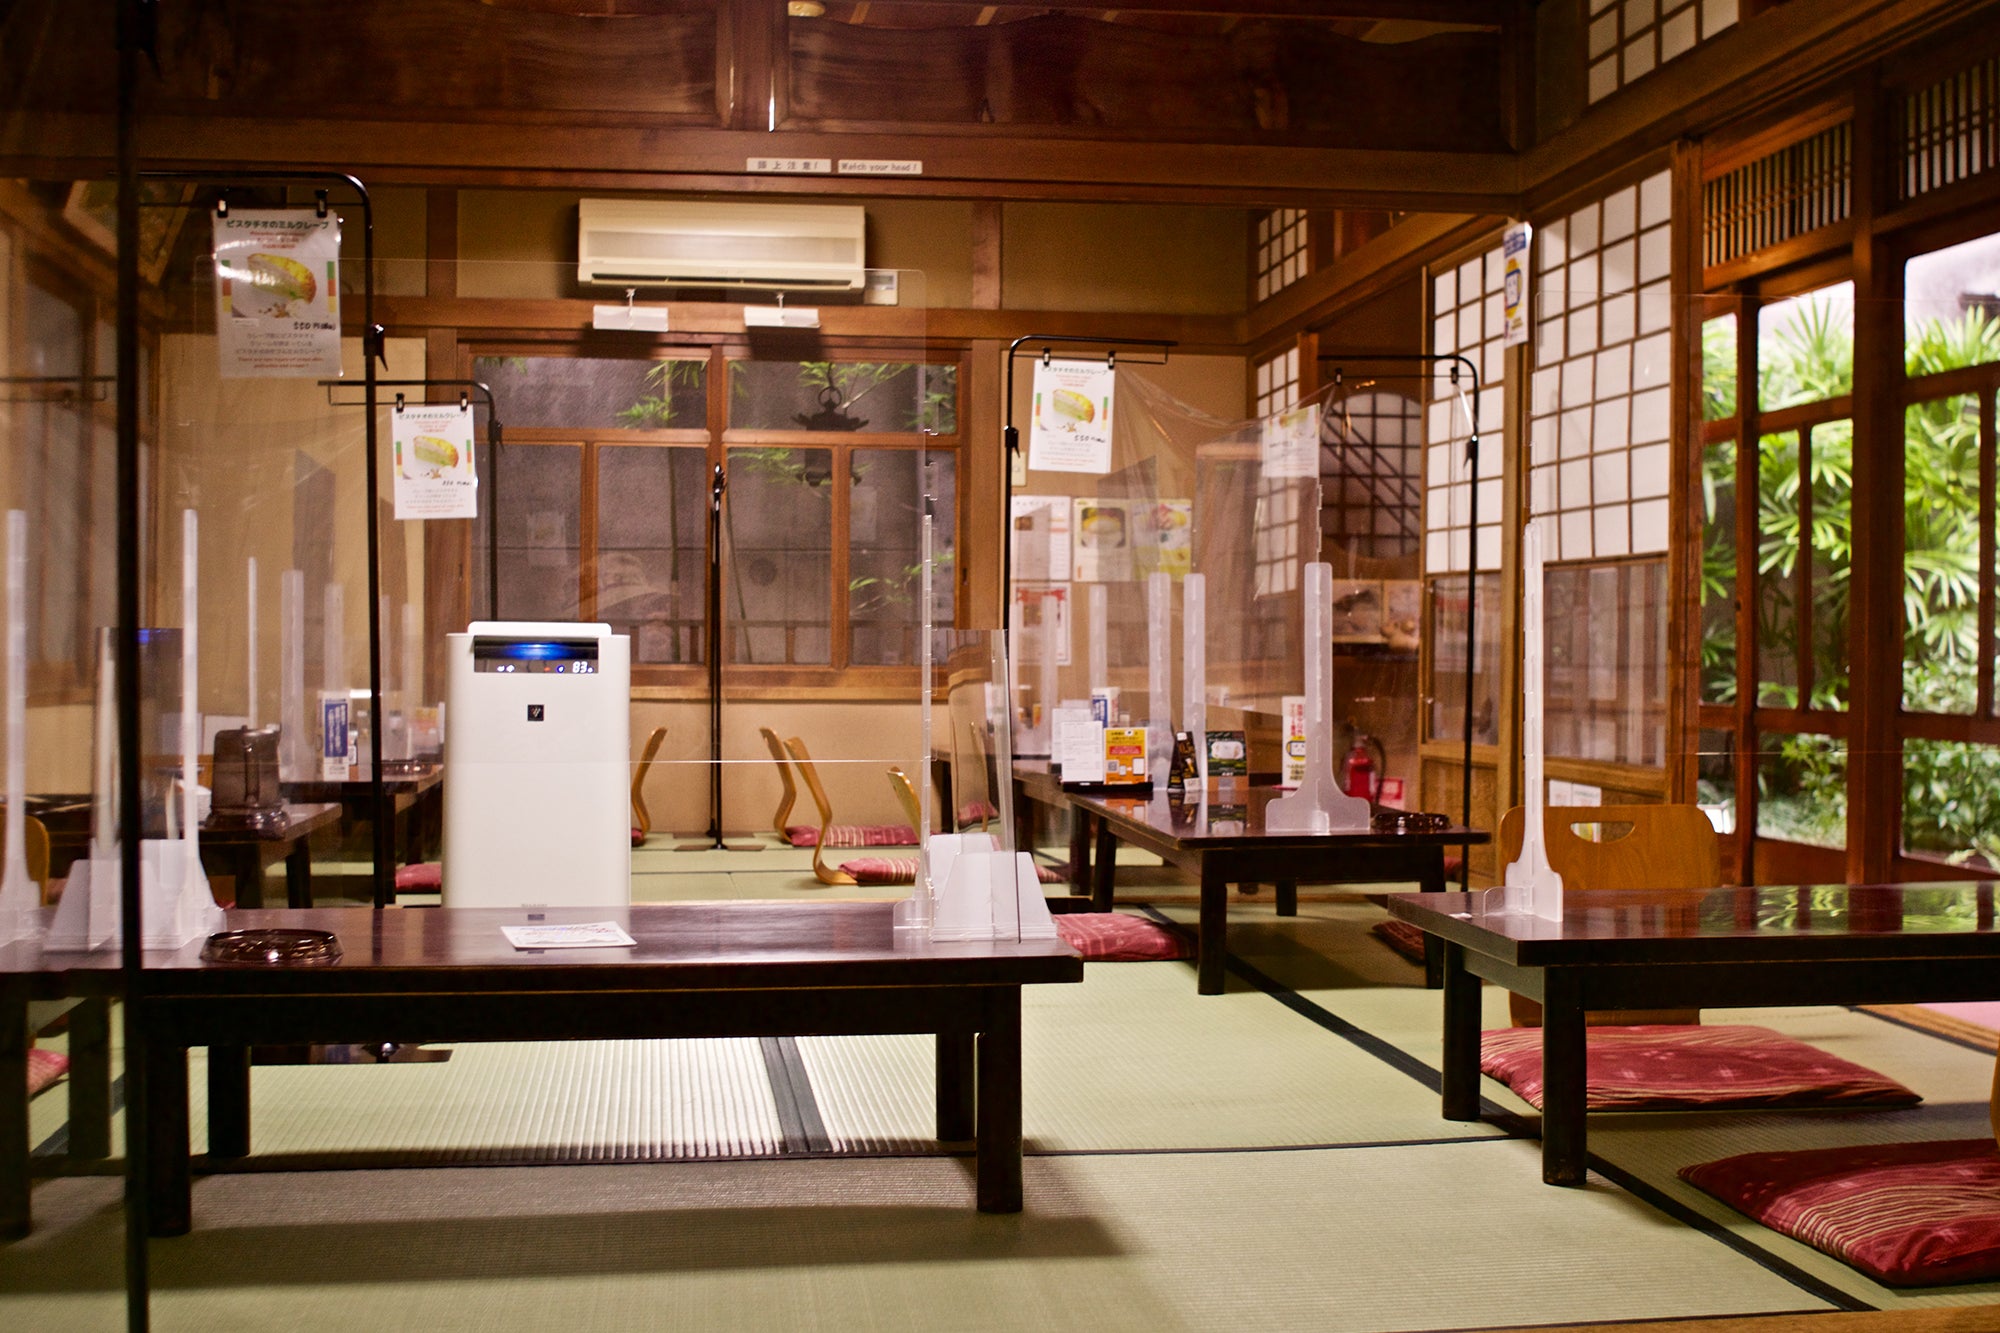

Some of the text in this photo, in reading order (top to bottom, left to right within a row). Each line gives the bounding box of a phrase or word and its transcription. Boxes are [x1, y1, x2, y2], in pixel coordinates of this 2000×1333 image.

[841, 162, 867, 171] Watch
[869, 164, 888, 172] your
[572, 661, 588, 674] 83
